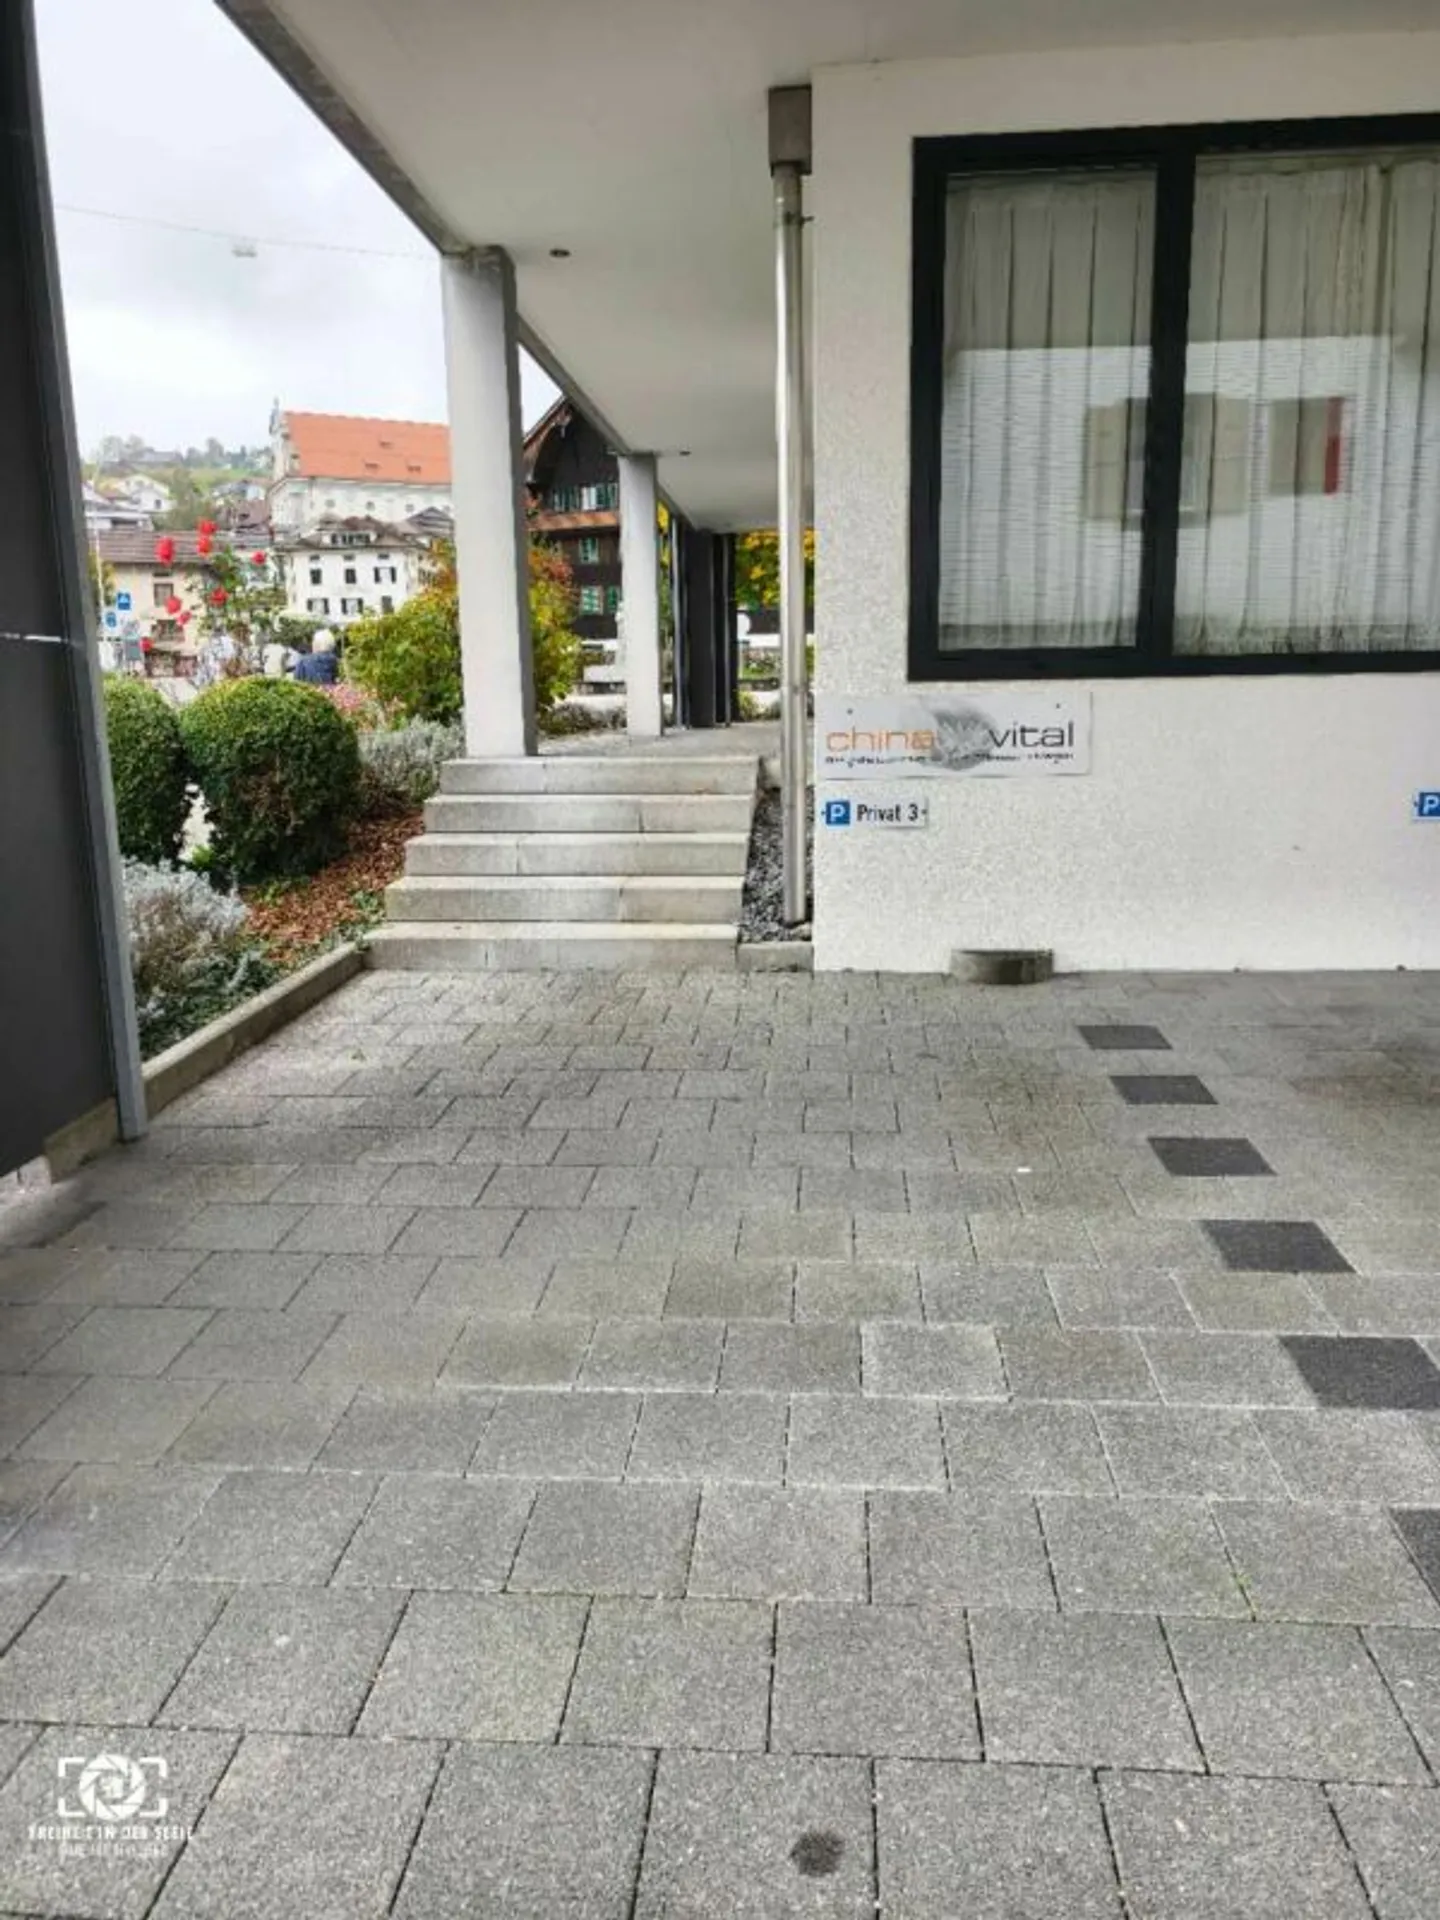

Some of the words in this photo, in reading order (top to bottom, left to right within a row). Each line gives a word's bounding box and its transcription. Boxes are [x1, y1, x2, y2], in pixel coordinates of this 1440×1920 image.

[826, 725, 935, 752] china
[988, 719, 1075, 748] vital
[830, 803, 846, 822] P
[856, 803, 902, 822] Privat
[907, 803, 919, 822] 3
[1422, 795, 1439, 815] P
